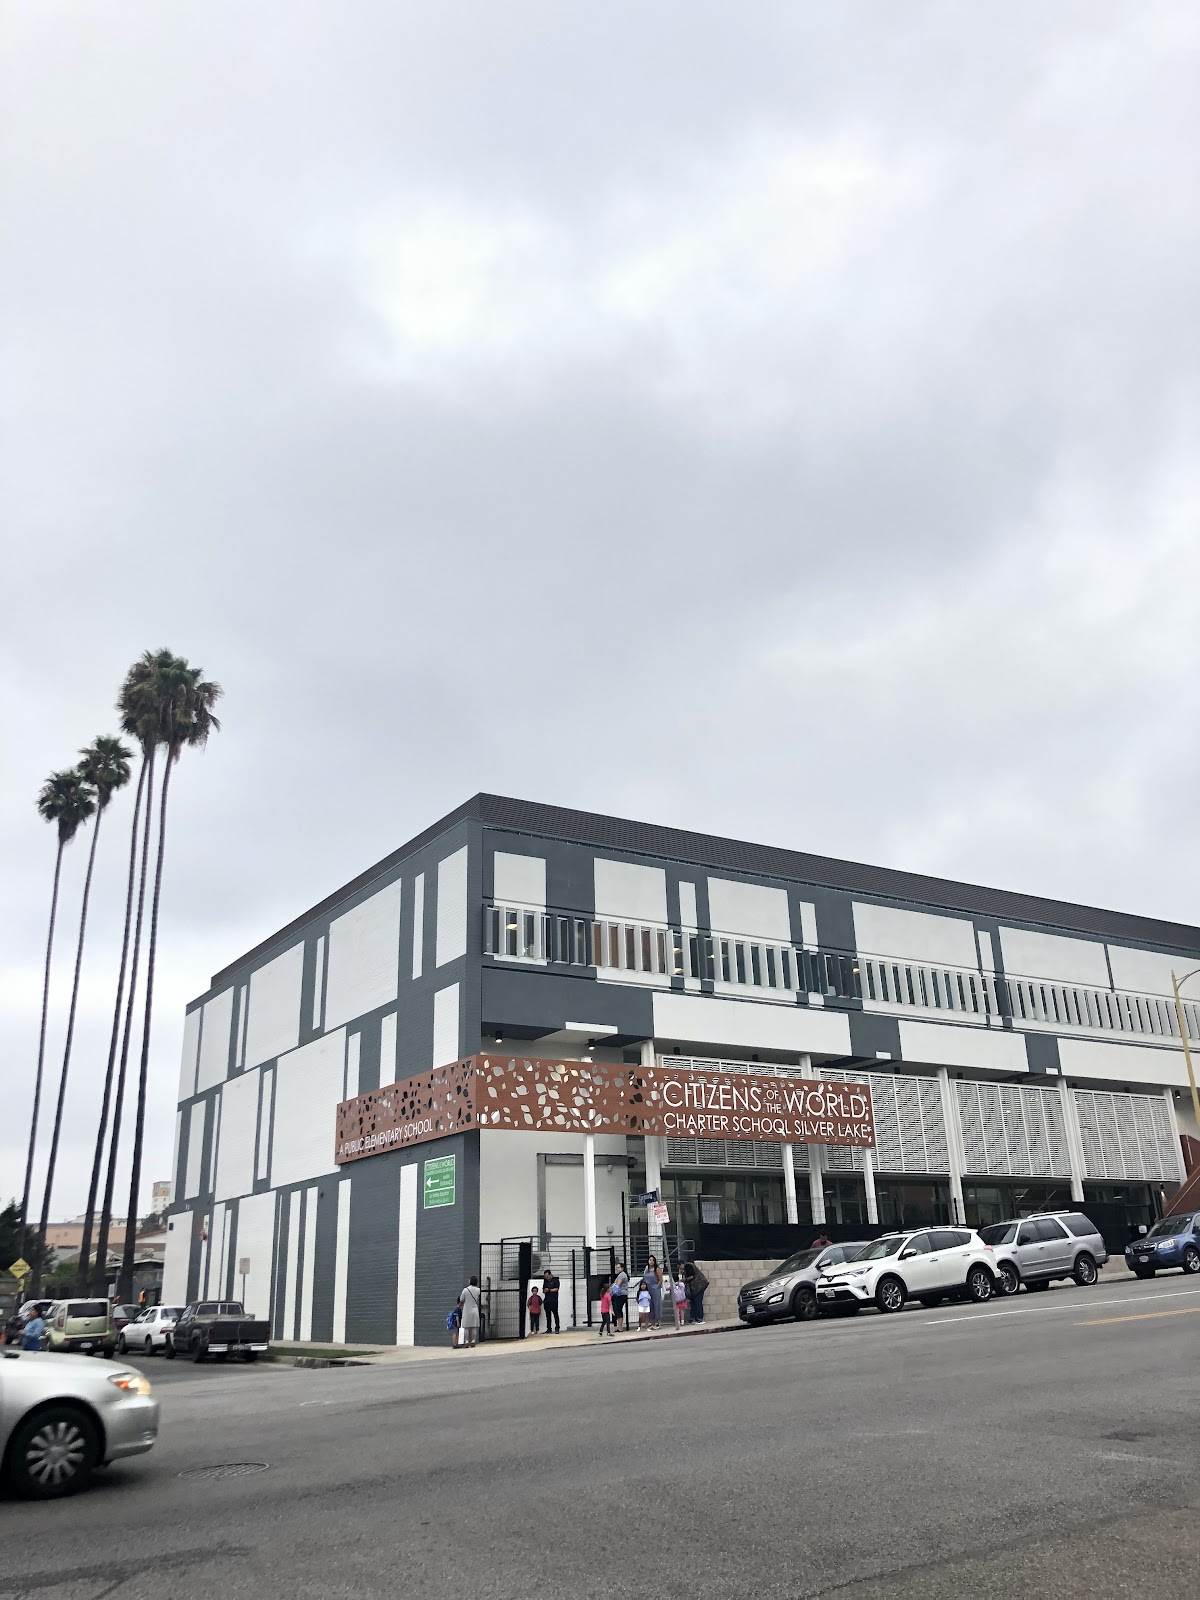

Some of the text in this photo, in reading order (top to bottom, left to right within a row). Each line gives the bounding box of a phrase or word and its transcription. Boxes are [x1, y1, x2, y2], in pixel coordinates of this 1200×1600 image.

[663, 1081, 866, 1119] CITIZENS OF WORLD
[766, 1103, 781, 1114] THE
[338, 1118, 433, 1156] A PUBLIC ELEMENTARY SCHOOL
[663, 1112, 869, 1138] CHARTER SCHOOL SILVER LAKE
